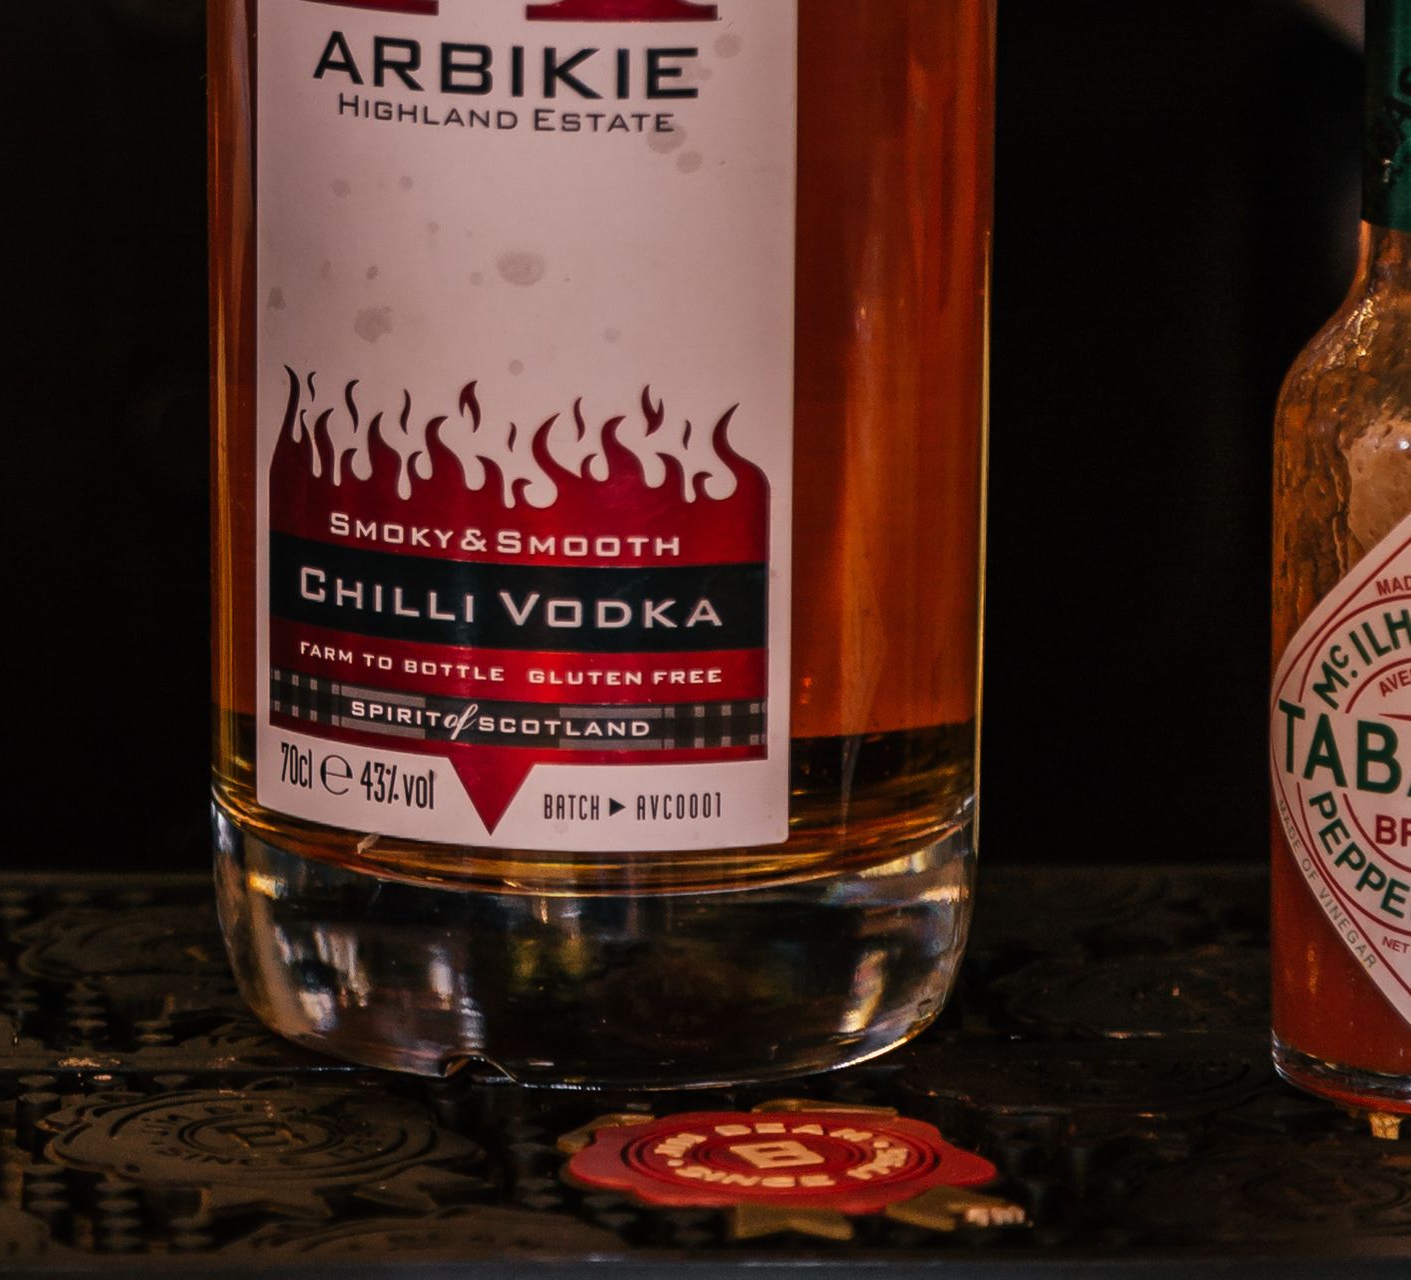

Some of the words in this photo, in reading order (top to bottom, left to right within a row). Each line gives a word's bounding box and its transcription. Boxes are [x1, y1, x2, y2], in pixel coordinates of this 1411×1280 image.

[313, 30, 699, 100] ARBIKIE
[338, 92, 518, 131] HIGHLAND
[534, 108, 675, 133] ESTATE
[299, 566, 475, 624] CHILLI
[500, 592, 723, 629] VODKA
[299, 641, 354, 665] FARM
[363, 653, 393, 671] TO
[404, 659, 505, 682] BOTTLE
[528, 669, 643, 686] GLUTEN
[652, 668, 723, 686] FREE
[351, 701, 442, 726] SPIRIT
[478, 715, 651, 738] SCOTLAND
[280, 741, 313, 789] 70cl
[1279, 699, 1411, 797] TAB
[543, 792, 601, 821] BATCH
[636, 791, 722, 821] AVC0001
[1301, 857, 1318, 882] OF
[1319, 887, 1377, 969] VINEGAR
[1381, 935, 1410, 954] NET
